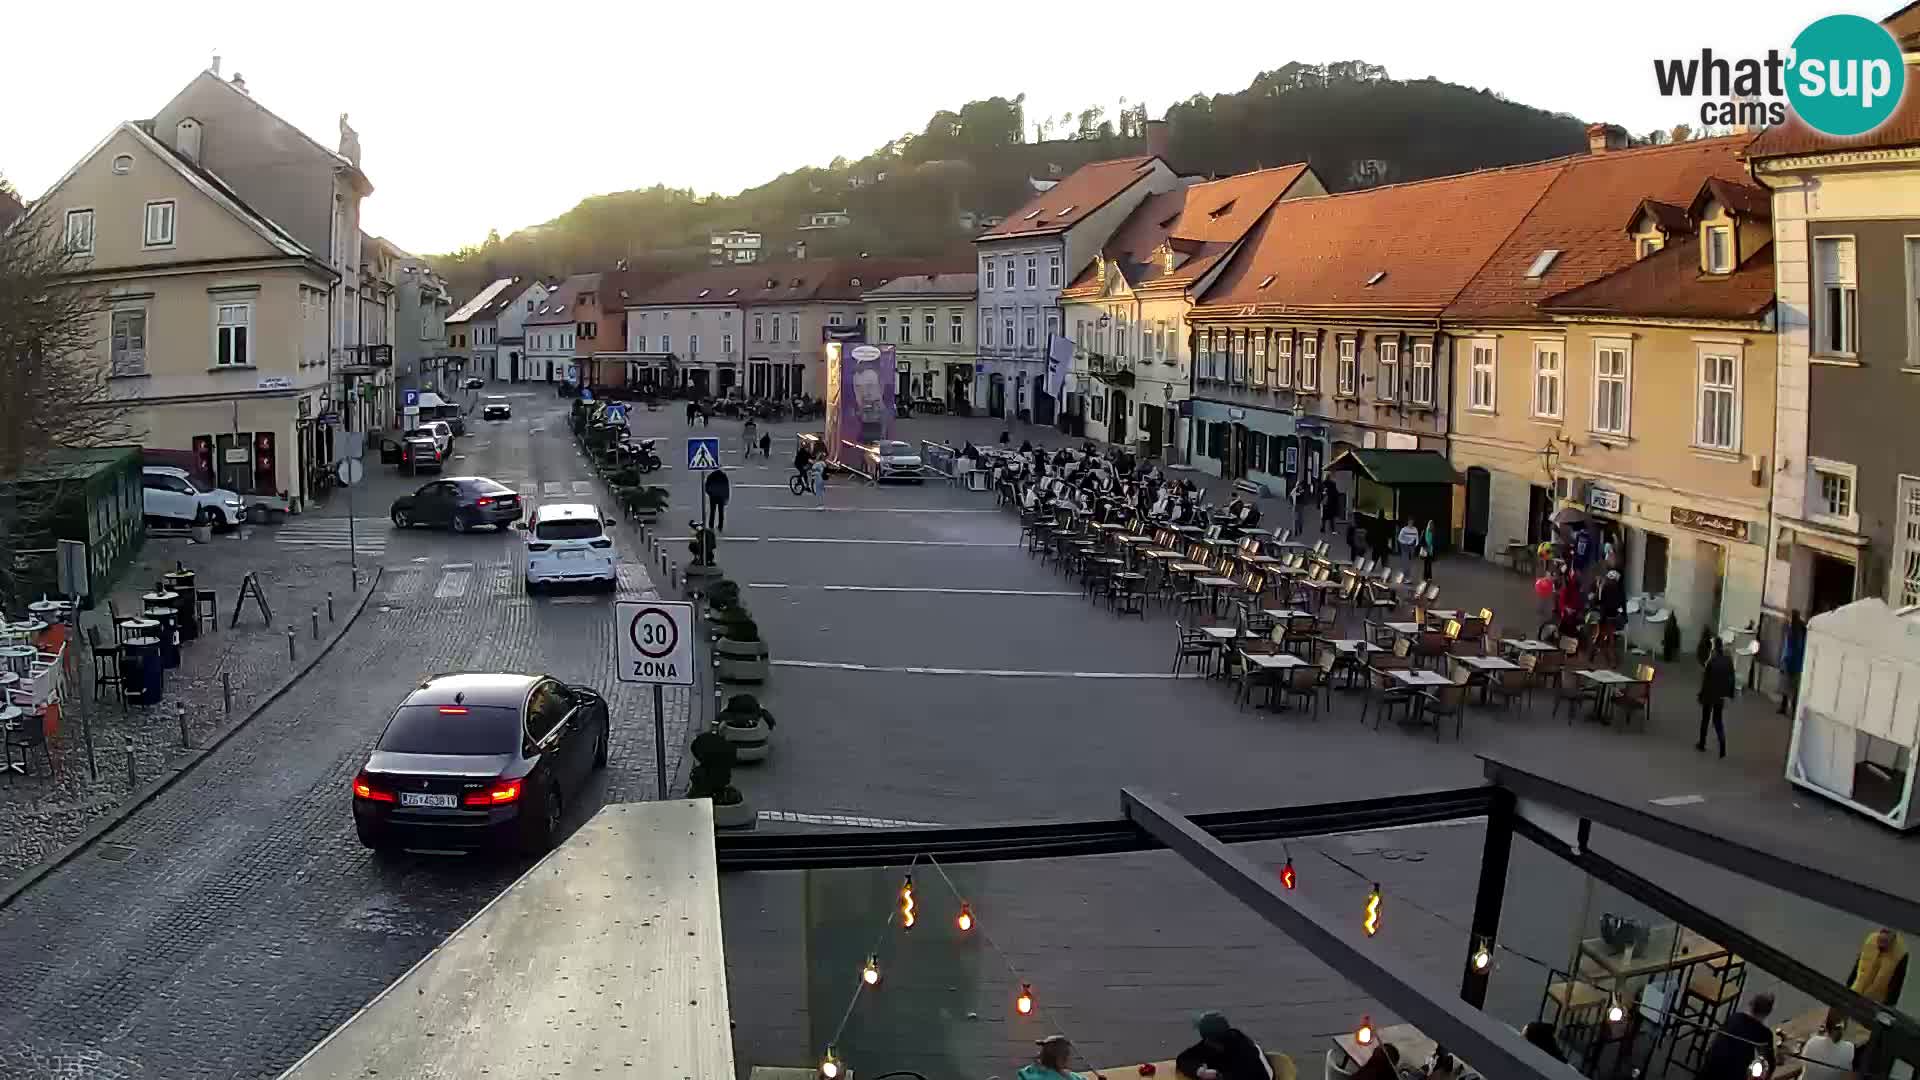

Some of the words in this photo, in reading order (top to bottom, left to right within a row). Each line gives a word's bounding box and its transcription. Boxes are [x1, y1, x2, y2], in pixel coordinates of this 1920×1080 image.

[407, 393, 415, 404] P
[643, 623, 667, 645] 30
[633, 661, 677, 677] ZONA
